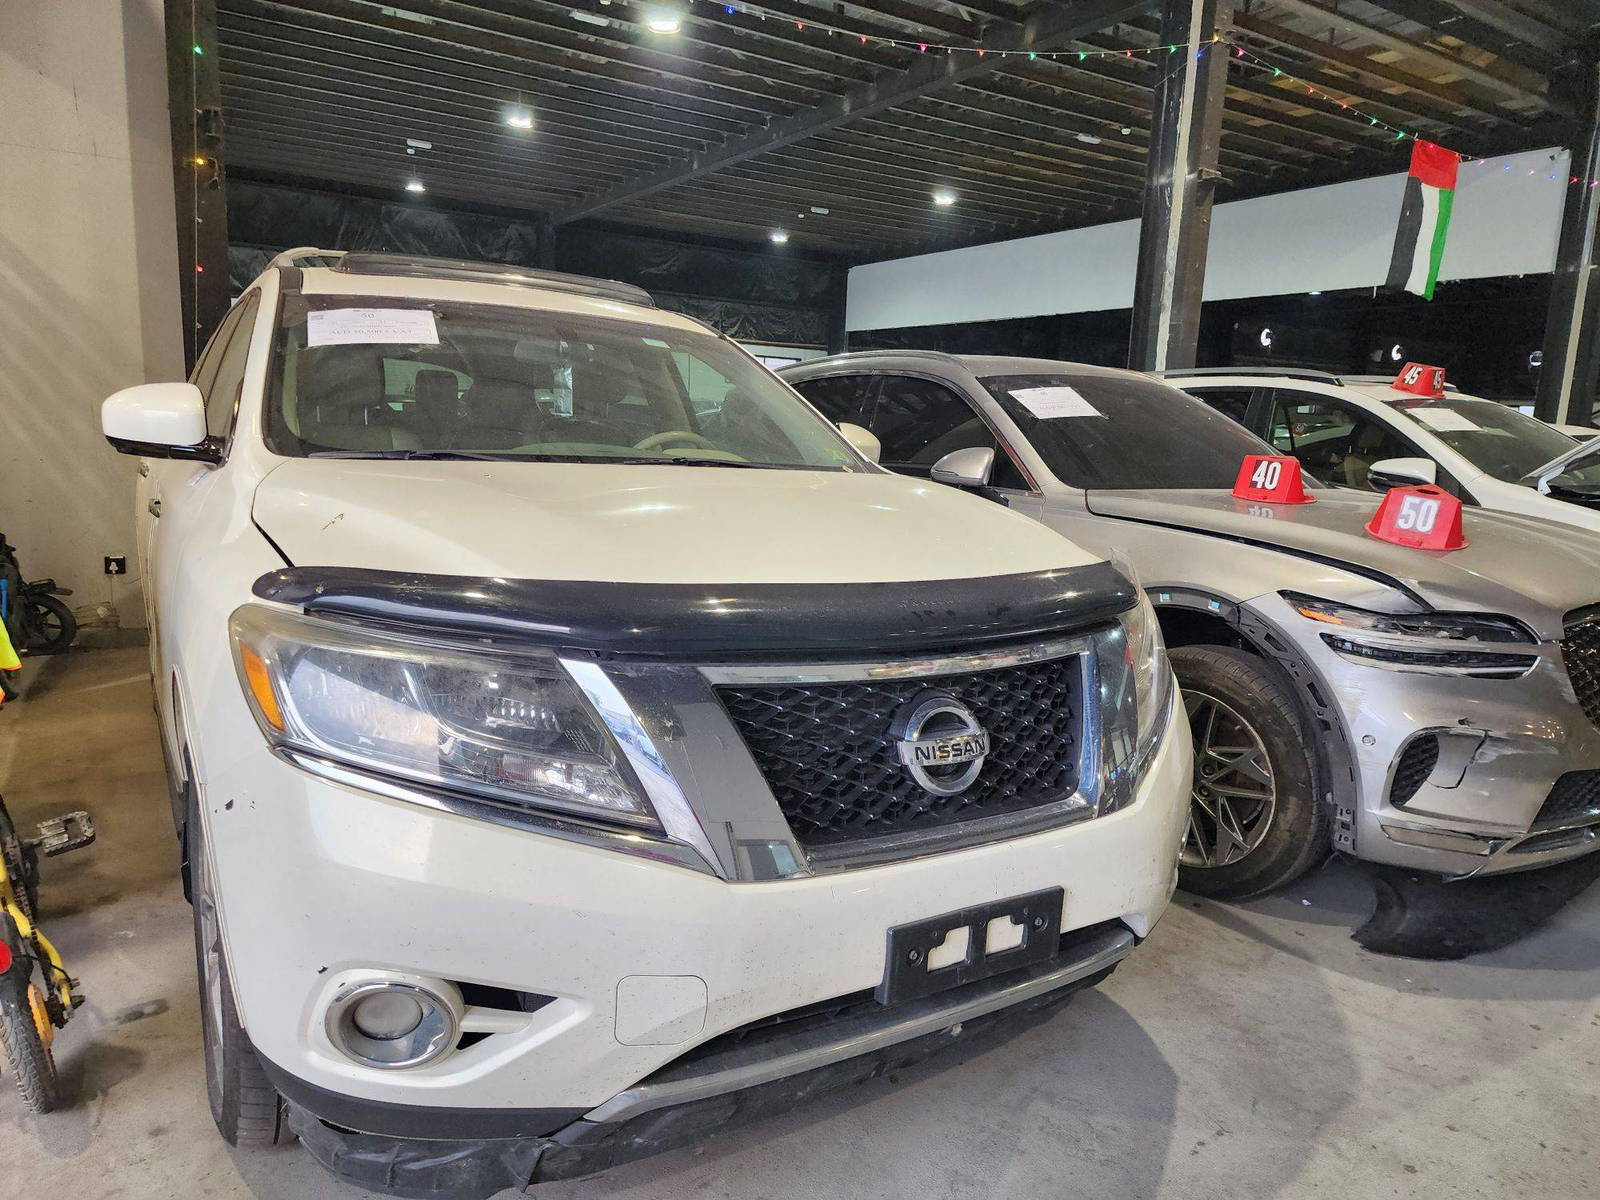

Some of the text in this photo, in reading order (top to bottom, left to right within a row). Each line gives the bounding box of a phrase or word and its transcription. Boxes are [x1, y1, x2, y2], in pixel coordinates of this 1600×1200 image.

[1403, 365, 1423, 385] 45
[1252, 460, 1282, 490] 40
[1398, 495, 1438, 533] 50
[914, 735, 985, 760] NISSAN
